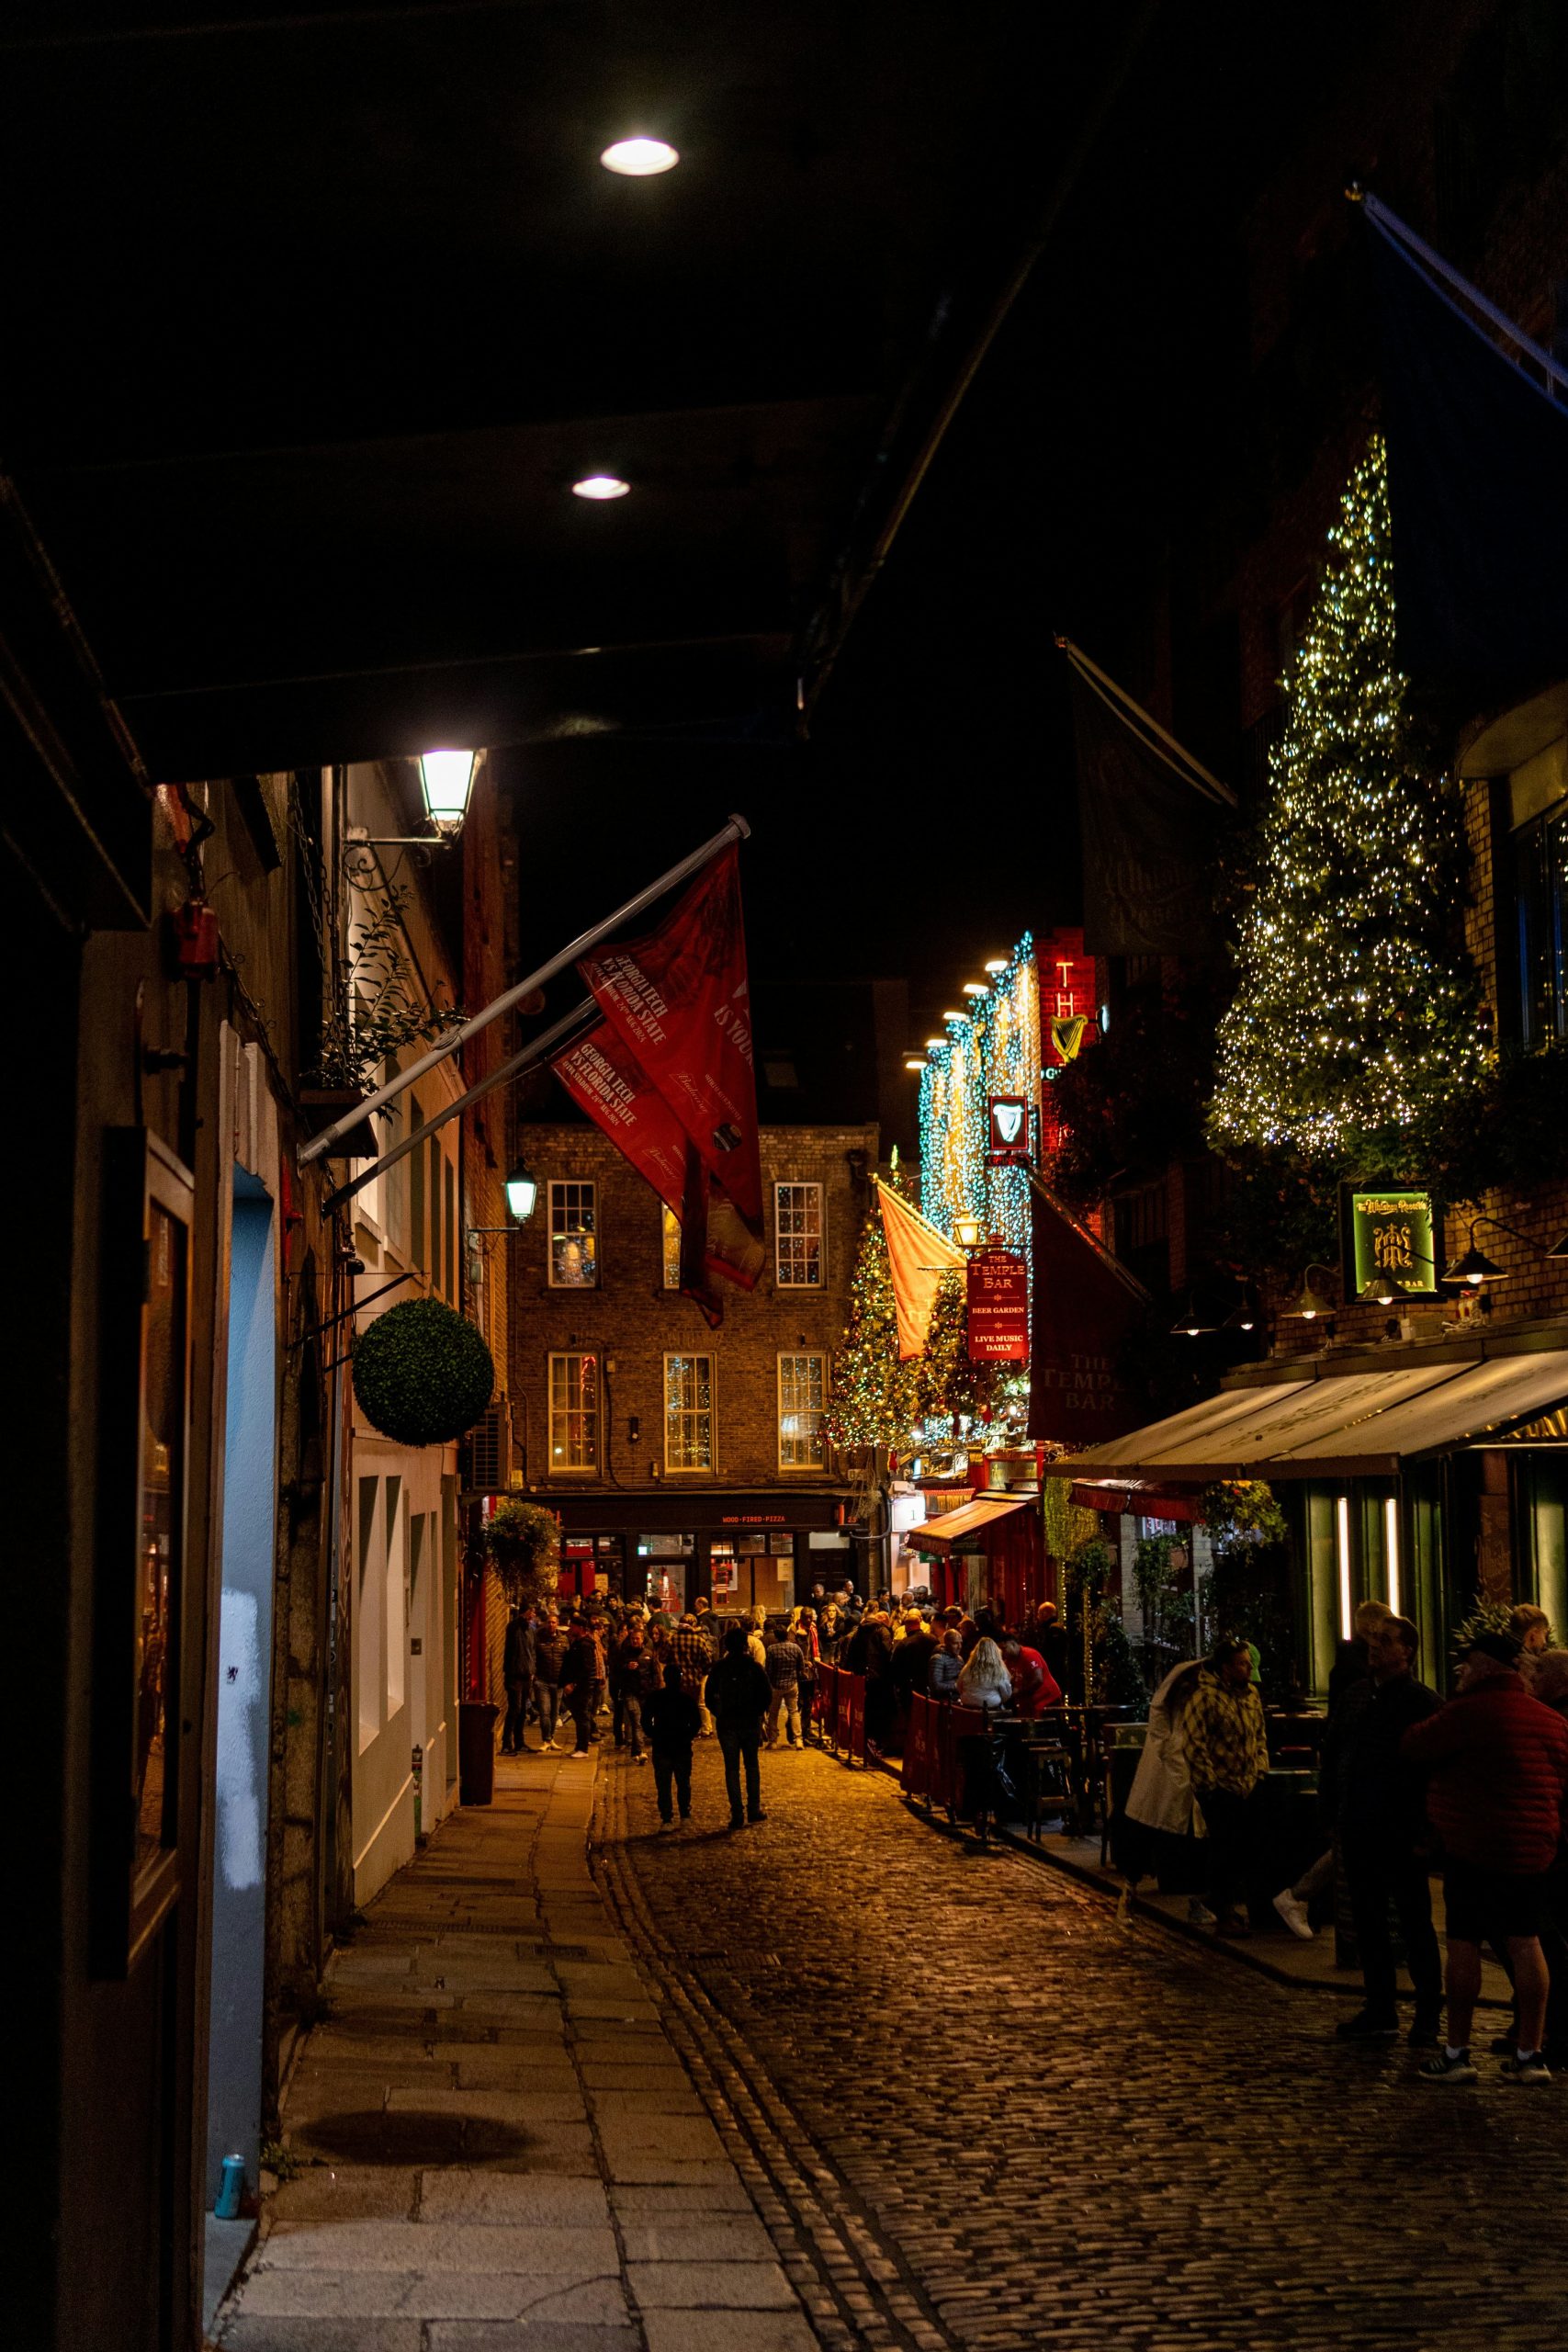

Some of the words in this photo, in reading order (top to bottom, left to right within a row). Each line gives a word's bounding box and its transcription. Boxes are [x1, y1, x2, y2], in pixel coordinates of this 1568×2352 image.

[601, 957, 617, 971] VS
[608, 971, 645, 1012] FLORIDA
[615, 955, 649, 992] GEORGIA
[641, 987, 669, 1018] TECH
[626, 1014, 637, 1029] AUG
[633, 1027, 647, 1043] 2024
[637, 1010, 667, 1046] STATE
[714, 1003, 735, 1026] IS
[581, 1044, 616, 1082] GEORGIA
[611, 1077, 637, 1104] TECH
[570, 1051, 586, 1066] VS
[579, 1062, 615, 1102] FLORIDA
[610, 1098, 637, 1127] STATE
[600, 1104, 611, 1115] AUG
[608, 1114, 620, 1126] 2024
[970, 1263, 1026, 1275] TEMPLE
[983, 1277, 1013, 1289] BAR
